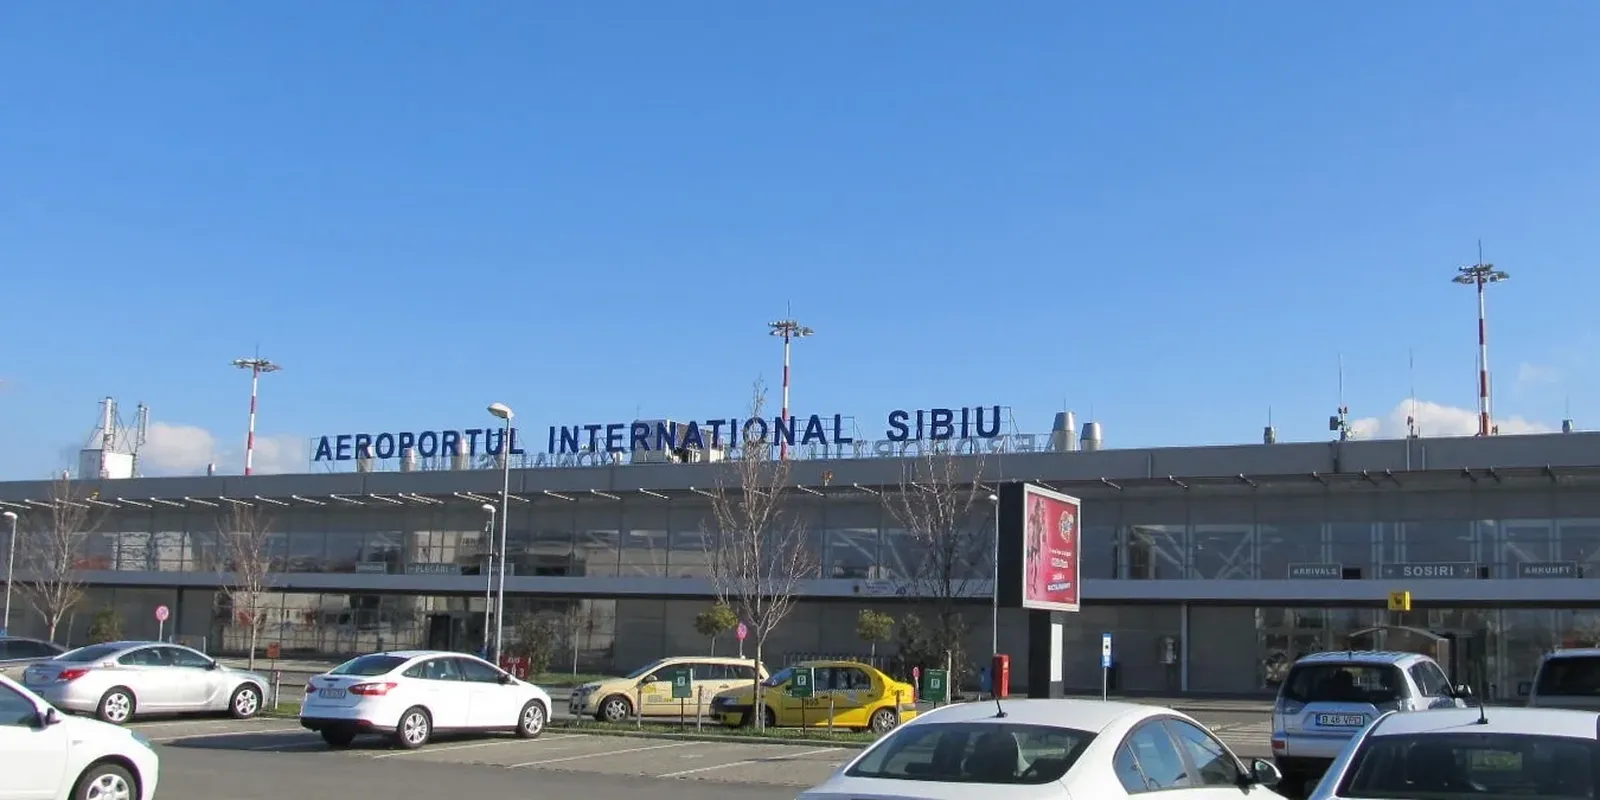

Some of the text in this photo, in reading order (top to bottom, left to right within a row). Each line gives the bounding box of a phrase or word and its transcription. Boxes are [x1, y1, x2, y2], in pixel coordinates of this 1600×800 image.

[314, 427, 524, 461] AEROPORTUL
[548, 413, 853, 453] INTERNATIONAL
[886, 405, 1000, 441] SIBIU
[1293, 567, 1337, 575] ARRIVALS
[1403, 566, 1454, 576] SOSIRI
[1524, 566, 1570, 574] ANKUNFT
